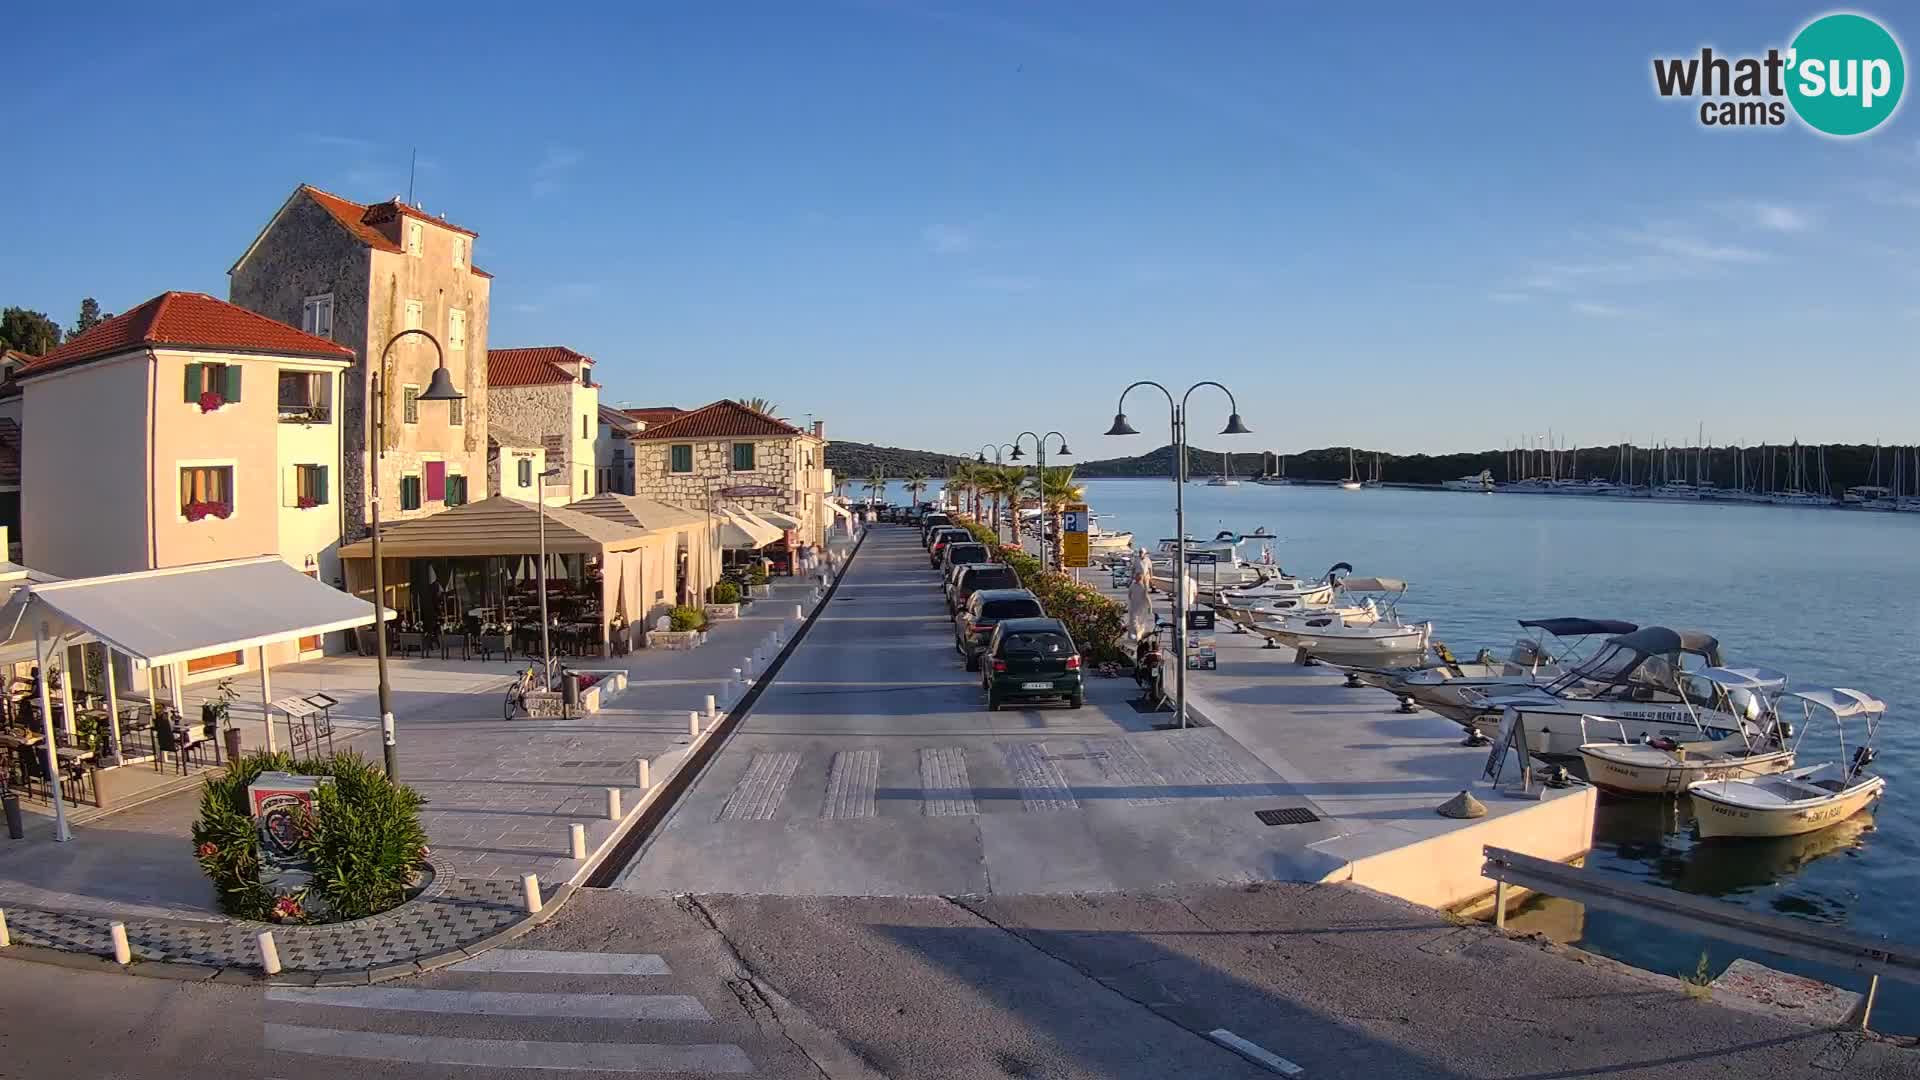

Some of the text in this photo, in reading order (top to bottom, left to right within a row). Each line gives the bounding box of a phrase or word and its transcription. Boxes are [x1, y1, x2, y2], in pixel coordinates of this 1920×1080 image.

[1065, 514, 1076, 530] P
[1656, 711, 1675, 721] RENT
[1676, 712, 1682, 721] A
